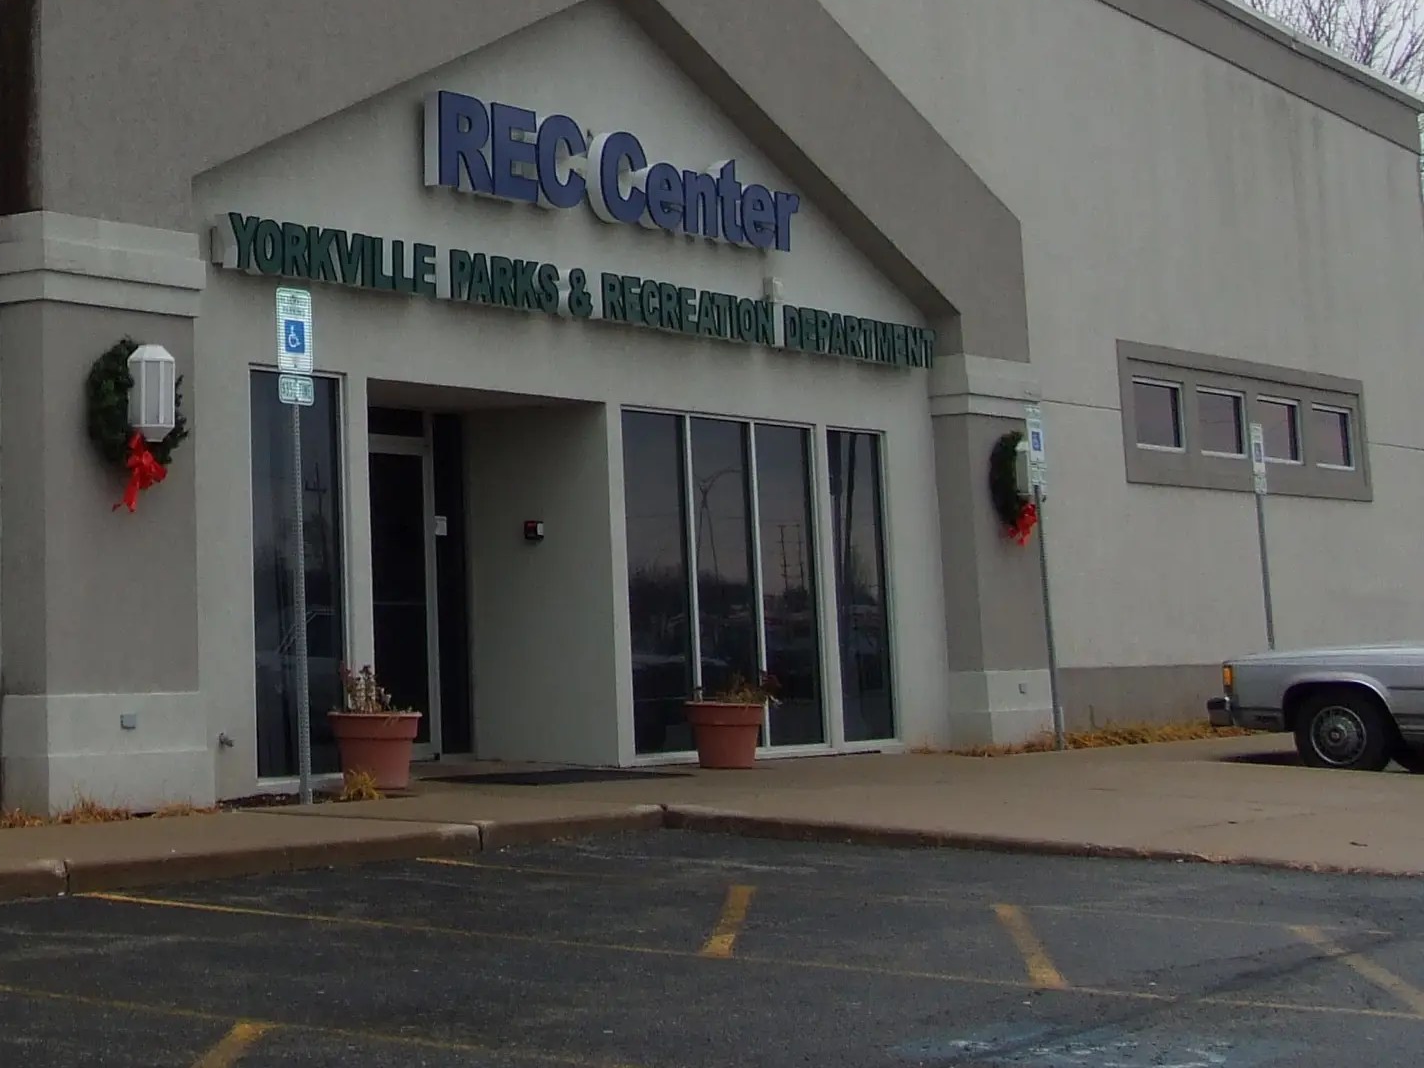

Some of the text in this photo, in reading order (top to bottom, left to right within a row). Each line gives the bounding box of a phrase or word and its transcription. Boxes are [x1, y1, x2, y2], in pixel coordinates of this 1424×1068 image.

[437, 90, 800, 252] REC Center
[228, 212, 936, 368] YORKVILLE PARKS & RECREATION DEPARTMENT
